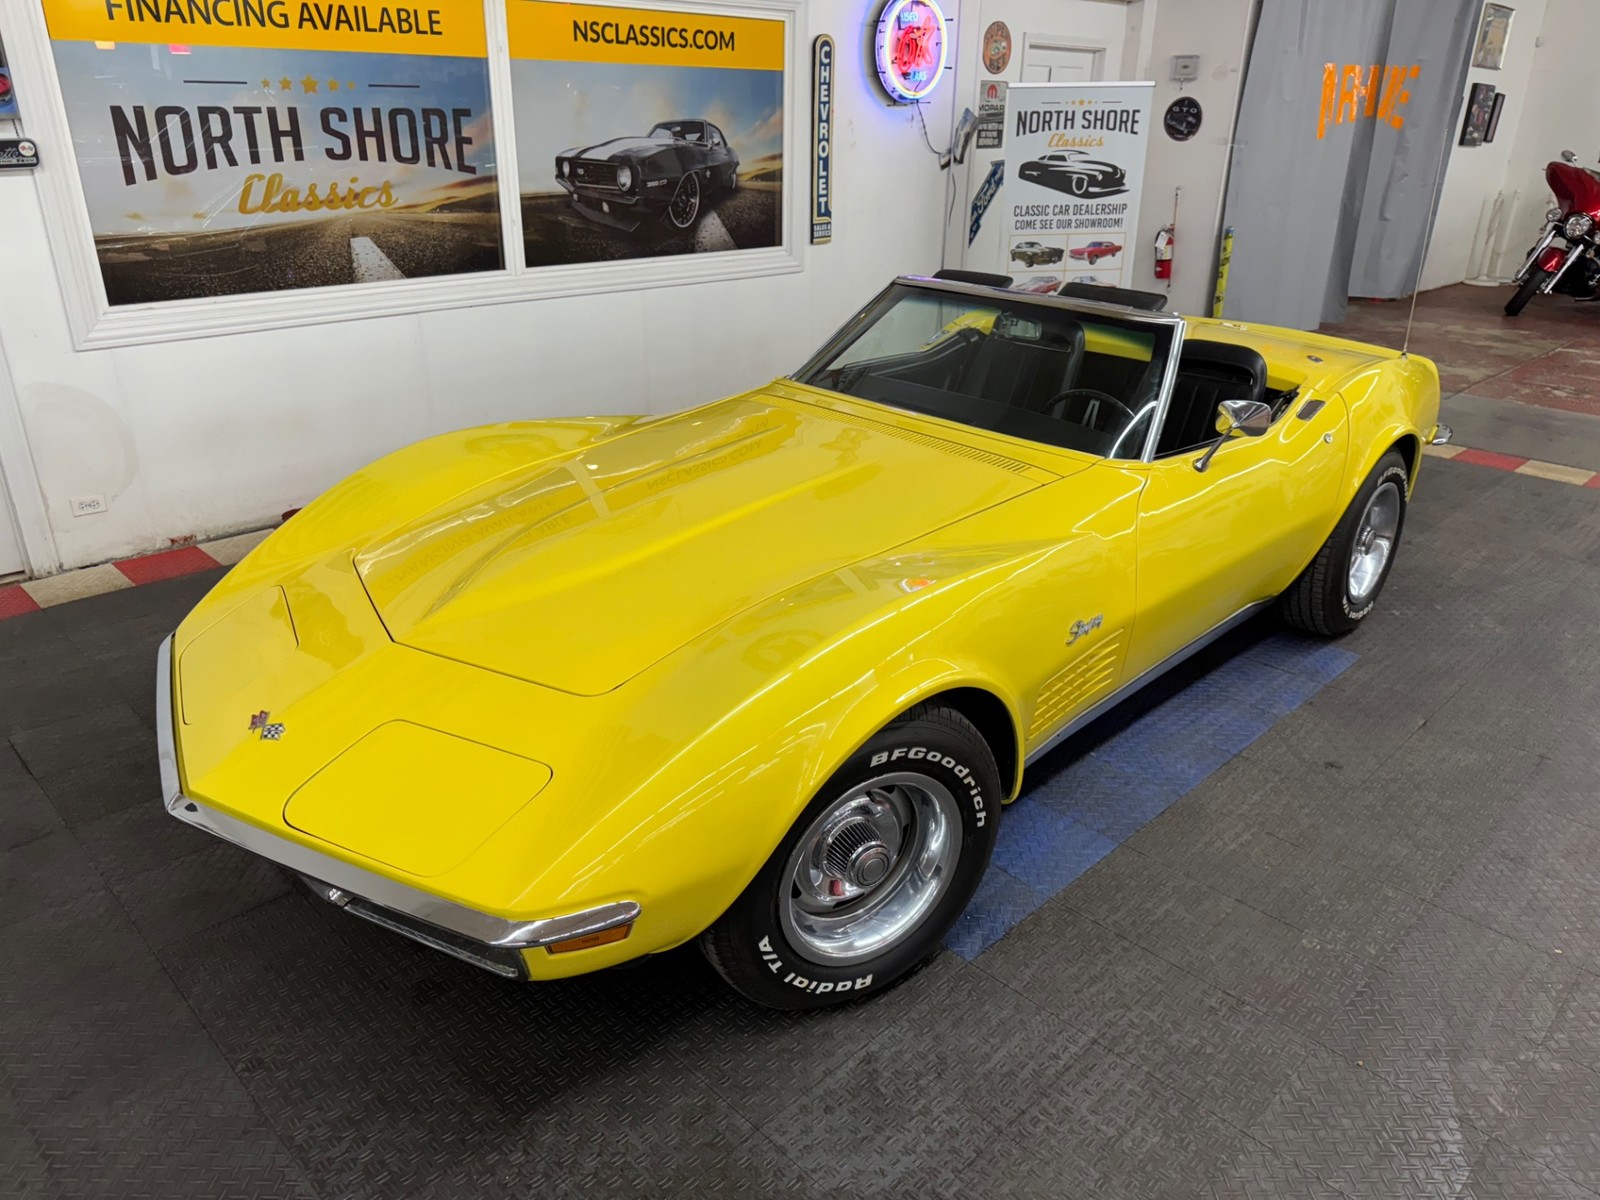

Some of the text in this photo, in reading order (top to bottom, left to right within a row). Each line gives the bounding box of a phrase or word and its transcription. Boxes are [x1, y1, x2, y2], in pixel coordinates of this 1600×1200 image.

[106, 0, 443, 36] FINANCING AVAILABLE
[572, 19, 736, 52] NSCLASSICS.COM
[817, 46, 831, 214] CHEVROLET
[1016, 109, 1141, 137] NORTH SHORE
[1047, 132, 1105, 148] Classics
[109, 104, 478, 187] NORTH SHORE
[237, 172, 398, 215] Classics
[1013, 203, 1128, 217] CLASSIC CAR DEALERSHIP
[1014, 217, 1124, 231] COME SEE OUR SHOWROOM!
[869, 747, 986, 828] BFGoodrich
[757, 935, 874, 995] Radial T/A
